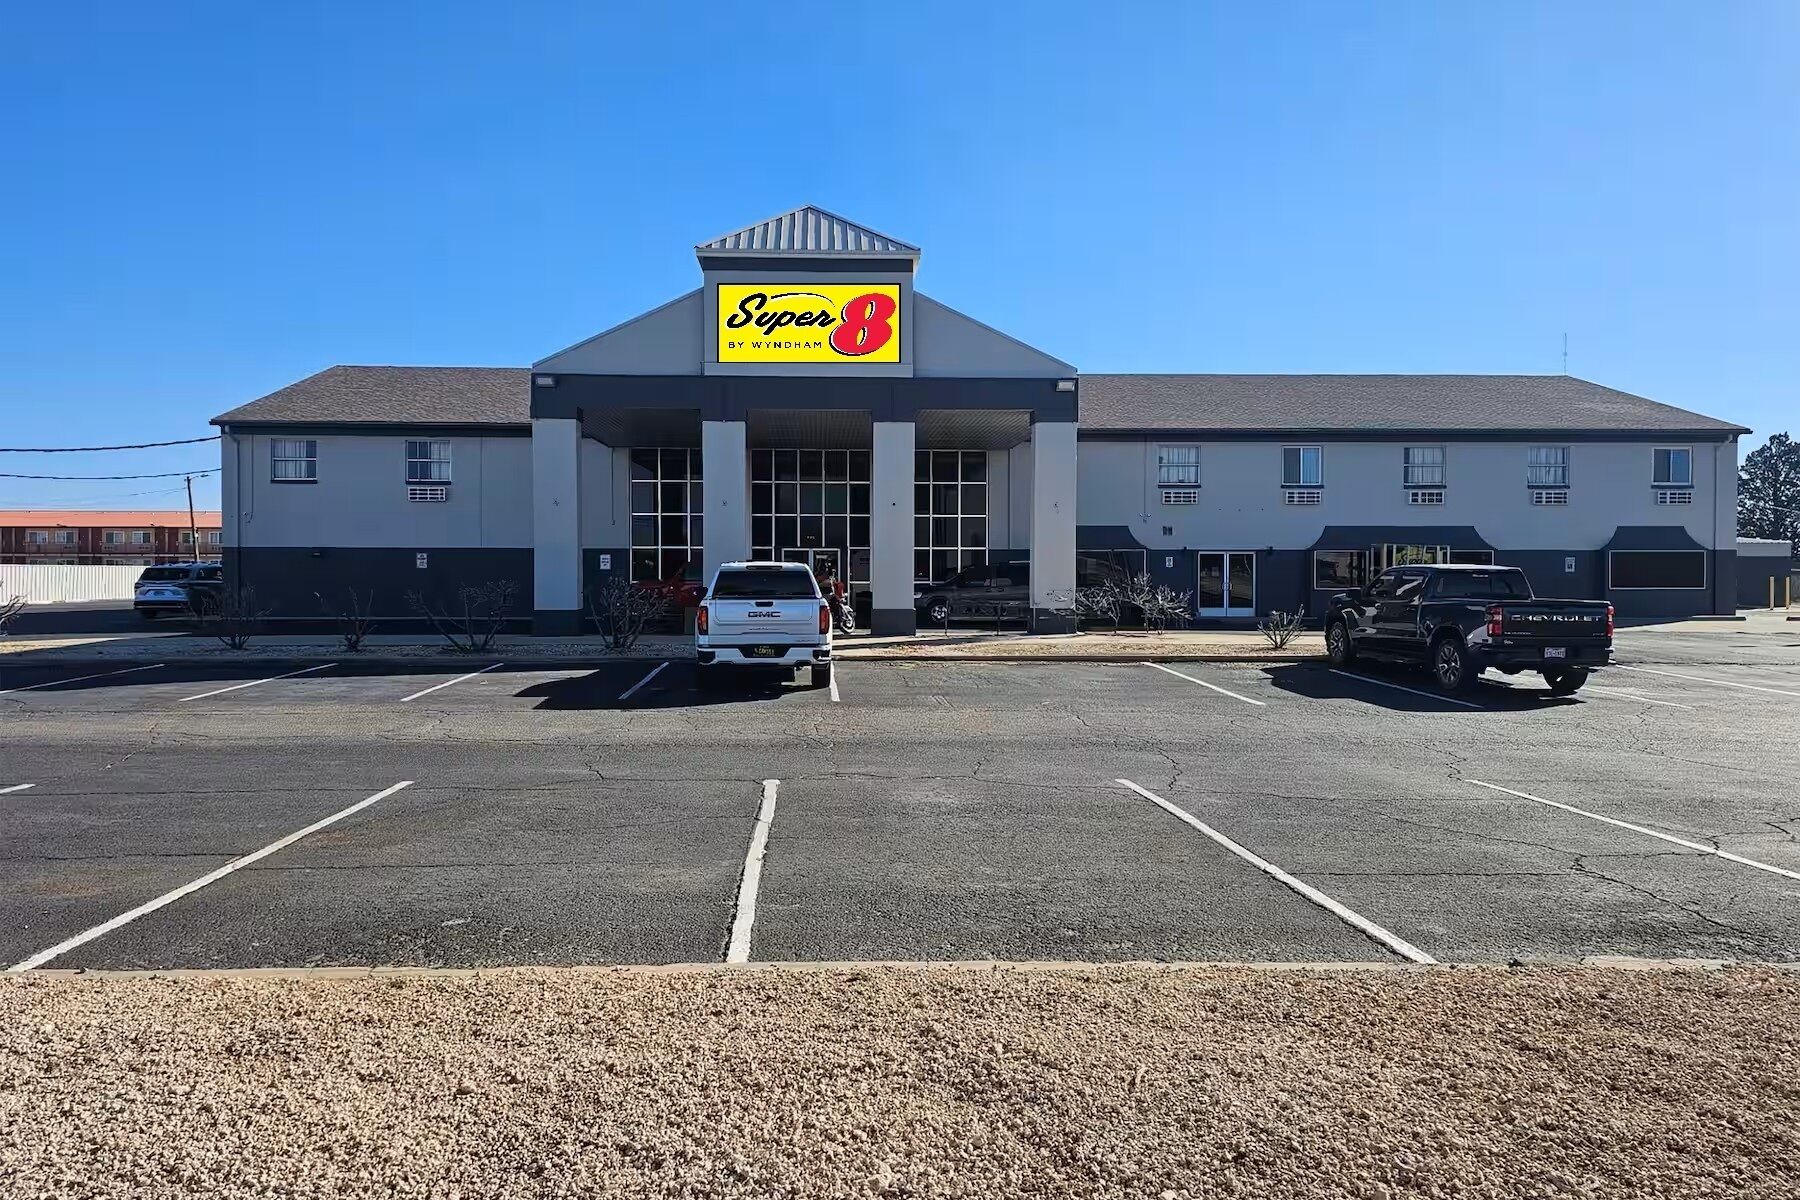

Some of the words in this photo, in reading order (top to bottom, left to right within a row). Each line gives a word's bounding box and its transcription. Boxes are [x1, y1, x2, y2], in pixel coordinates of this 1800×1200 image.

[726, 292, 837, 336] Super
[828, 292, 897, 357] 8
[728, 341, 745, 349] BY
[751, 341, 822, 349] WYNDHAM
[1511, 614, 1602, 622] CHEVROLET
